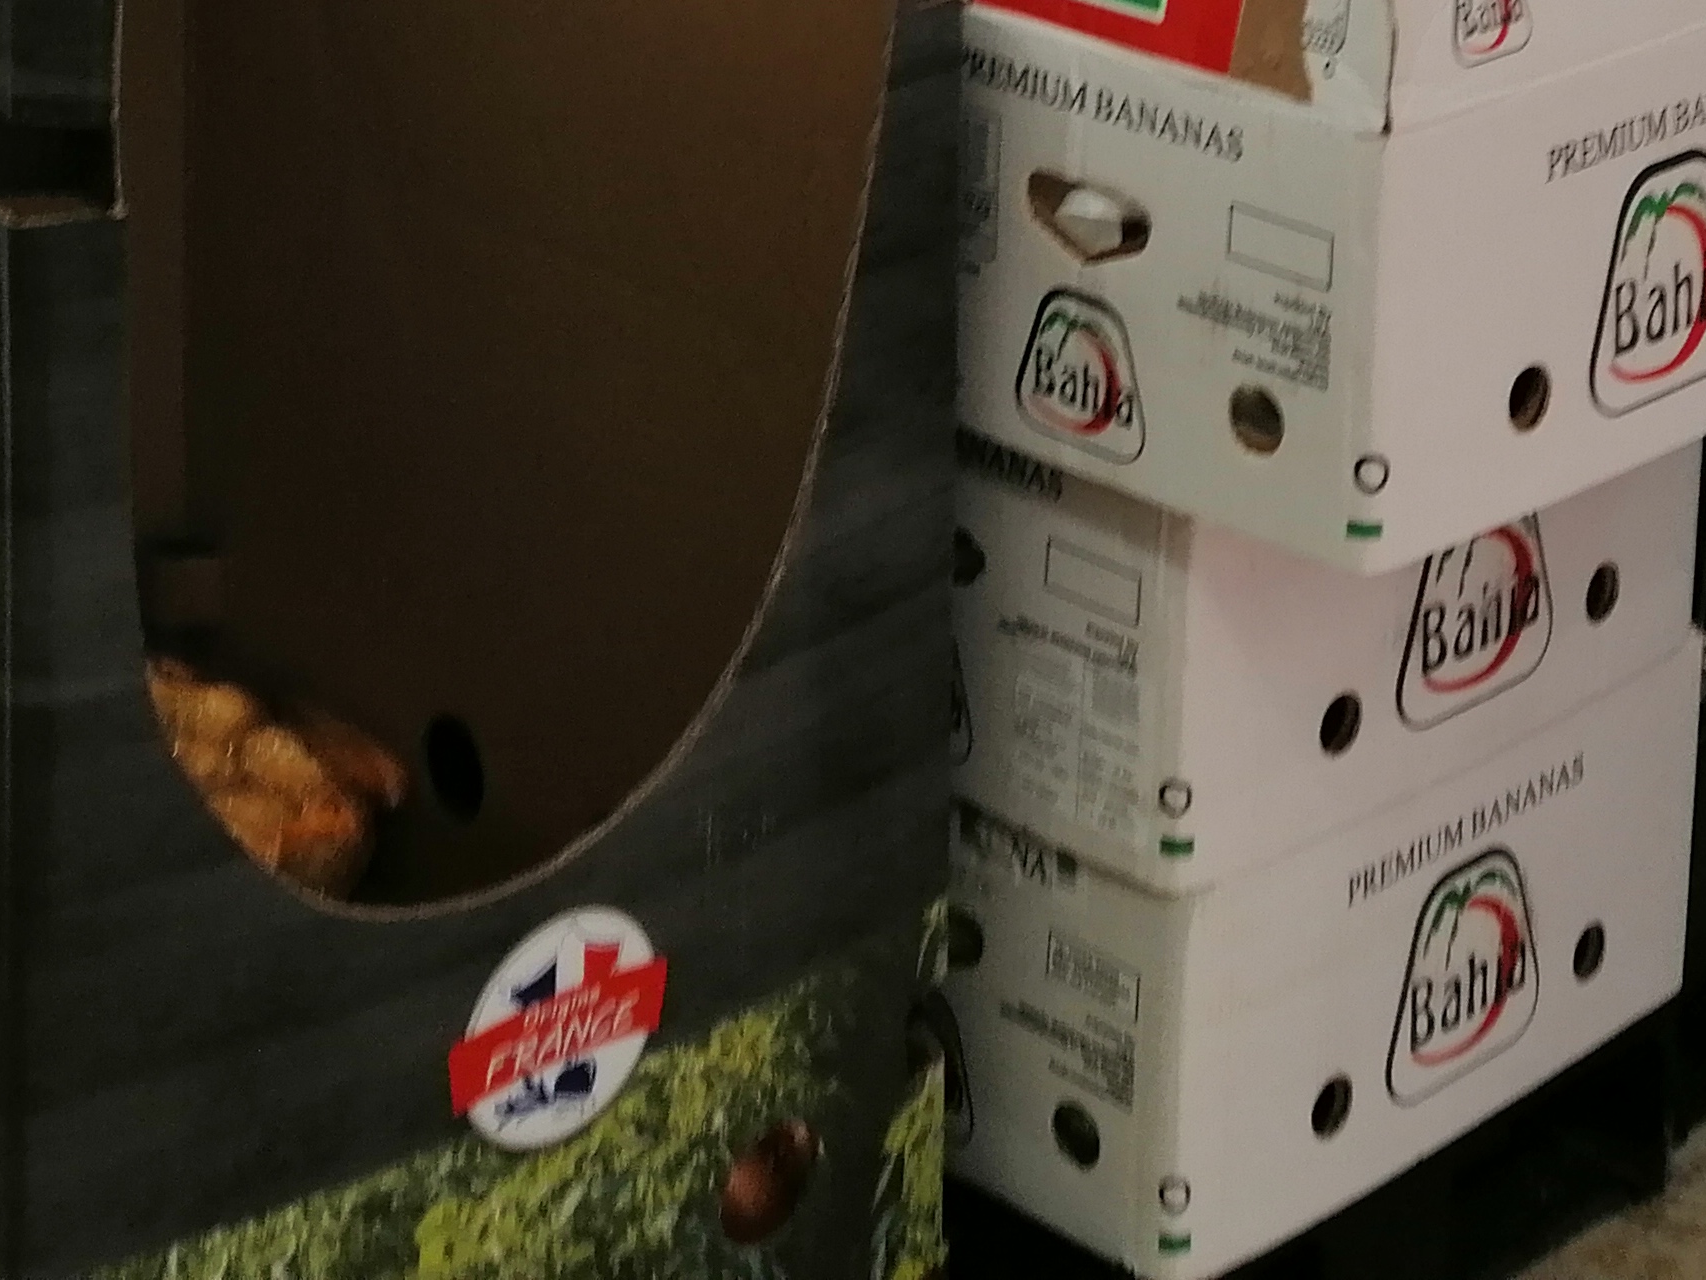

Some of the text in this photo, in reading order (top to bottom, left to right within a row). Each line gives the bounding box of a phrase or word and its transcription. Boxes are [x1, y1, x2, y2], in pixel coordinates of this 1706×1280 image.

[960, 44, 1245, 163] PREMIUM BANANAS
[1544, 107, 1669, 185] PREMIUM
[1032, 342, 1135, 431] Bahia
[1422, 569, 1540, 678] Bahia
[1348, 750, 1585, 909] PREMIUM BANANAS
[485, 988, 642, 1093] FRANCE
[1410, 935, 1527, 1054] Bahia
